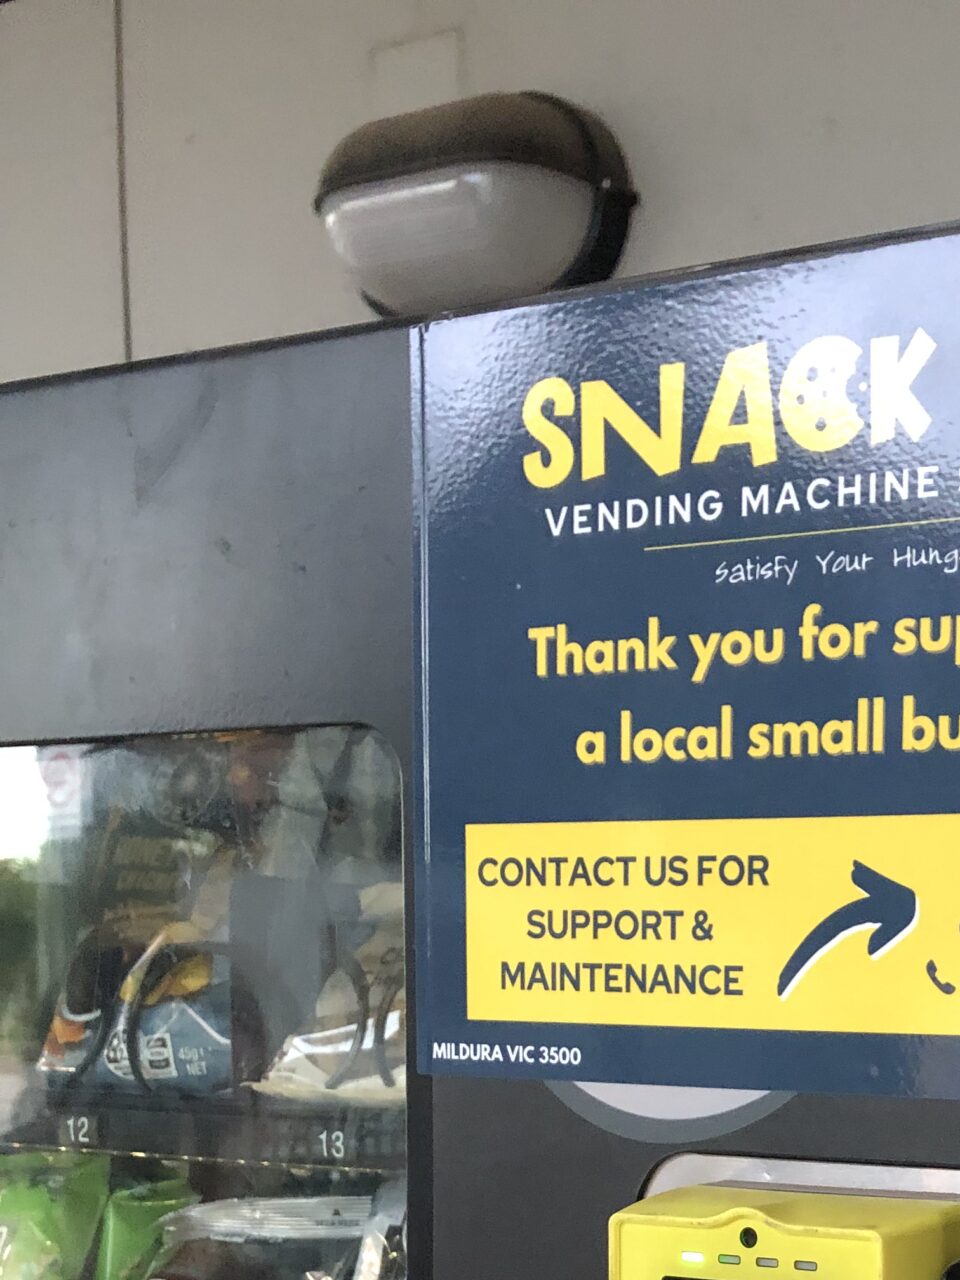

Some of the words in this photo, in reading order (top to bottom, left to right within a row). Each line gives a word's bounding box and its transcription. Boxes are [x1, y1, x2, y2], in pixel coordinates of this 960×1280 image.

[521, 326, 937, 490] SNACK
[545, 488, 724, 537] VENDING
[740, 466, 939, 519] MACHINE
[815, 550, 875, 575] Your
[528, 615, 675, 678] Thank
[690, 627, 785, 682] you
[799, 602, 878, 660] for
[575, 723, 606, 764] a
[619, 706, 734, 764] local
[746, 697, 885, 759] small
[478, 856, 636, 886] CONTACT
[644, 855, 689, 886] US
[698, 855, 770, 886] FOR
[527, 910, 683, 939] SUPPORT
[692, 911, 714, 940] &
[500, 961, 744, 996] MAINTENANCE
[432, 1042, 503, 1062] MILDURA
[507, 1045, 535, 1063] VIC
[539, 1046, 581, 1065] 3500
[67, 1117, 89, 1143] 12
[318, 1130, 345, 1158] 13
